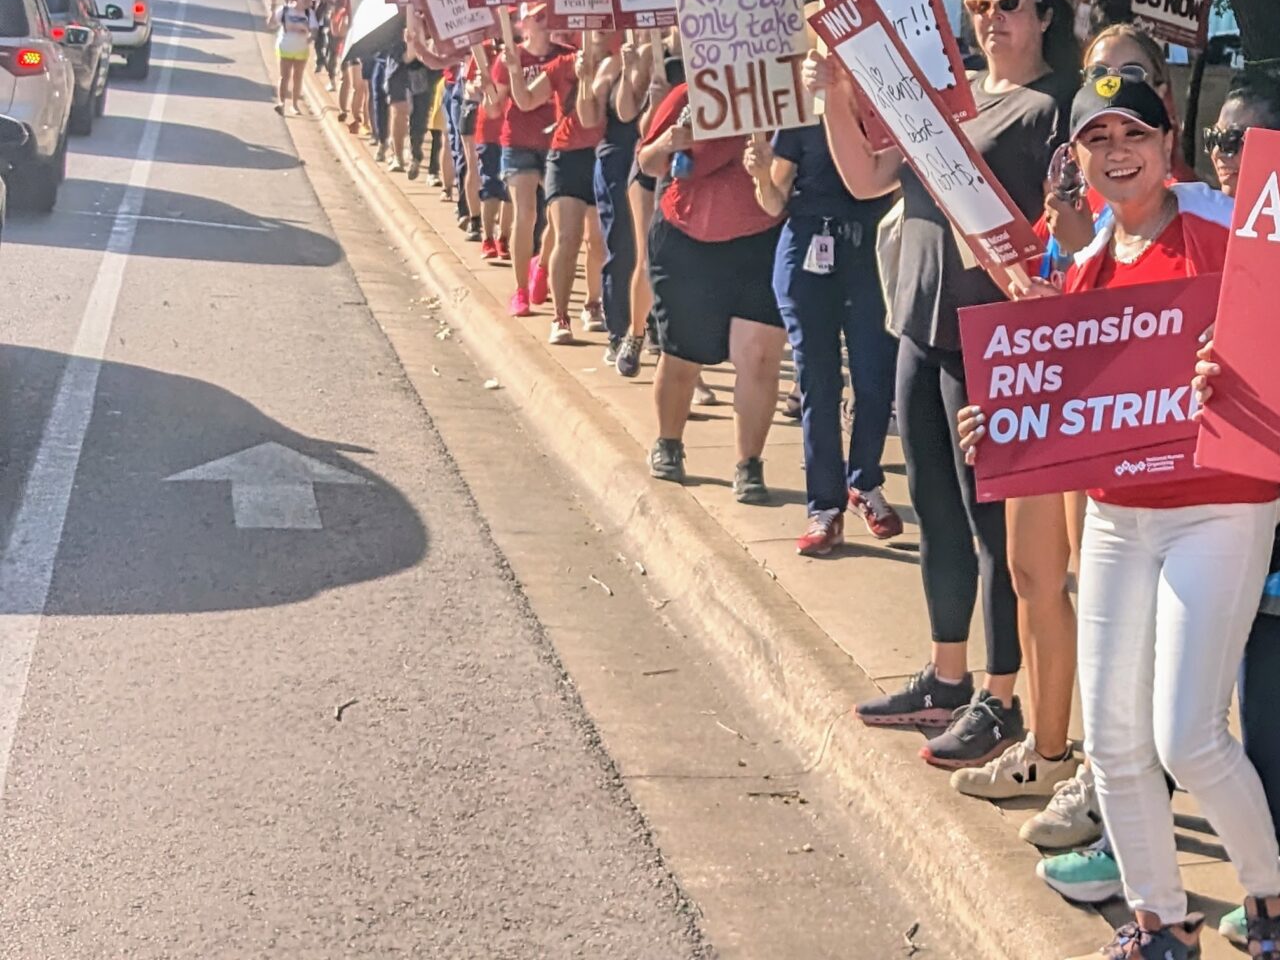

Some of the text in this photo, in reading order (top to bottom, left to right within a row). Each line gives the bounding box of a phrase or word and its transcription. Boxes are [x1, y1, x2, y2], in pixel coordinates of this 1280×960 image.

[680, 7, 738, 39] only
[748, 6, 805, 38] take
[729, 36, 794, 63] much
[694, 52, 810, 132] SHIFT
[983, 306, 1184, 360] Ascension
[989, 361, 1063, 400] RNs
[988, 403, 1051, 444] ON
